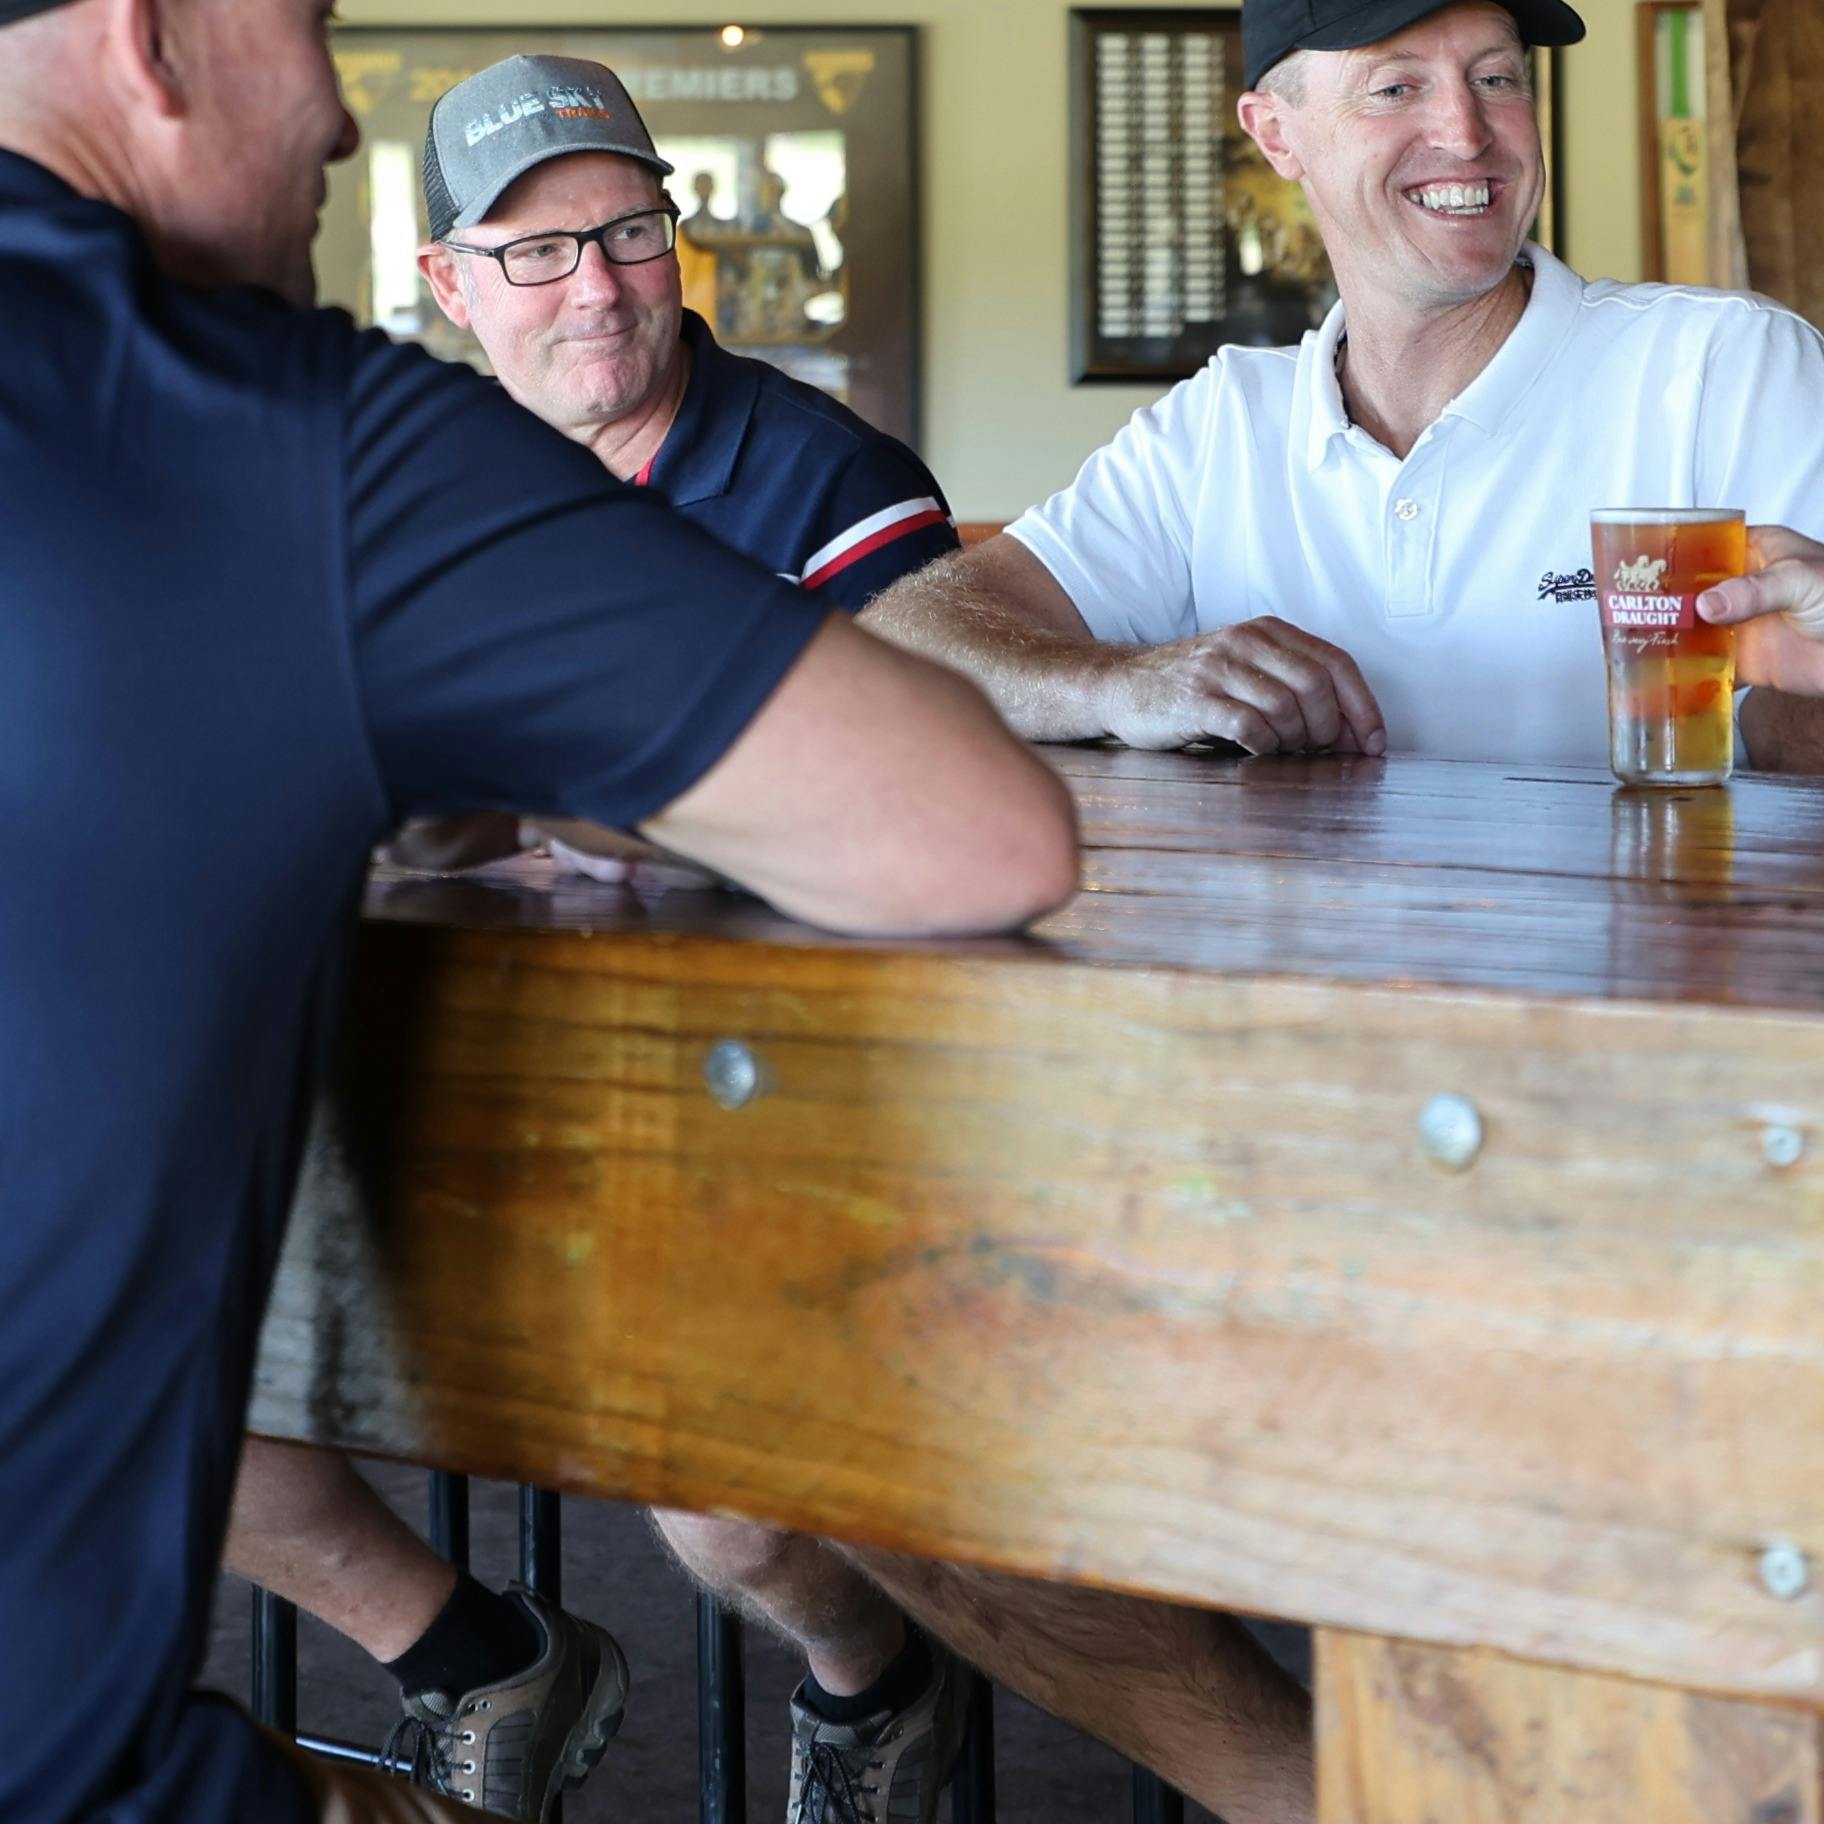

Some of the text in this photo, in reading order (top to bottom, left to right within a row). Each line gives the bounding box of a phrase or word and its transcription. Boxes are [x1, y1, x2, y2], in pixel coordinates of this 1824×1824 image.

[464, 85, 606, 147] BLUE SKY
[1608, 594, 1683, 611] CARLTON
[1612, 610, 1680, 625] DRAUGHT
